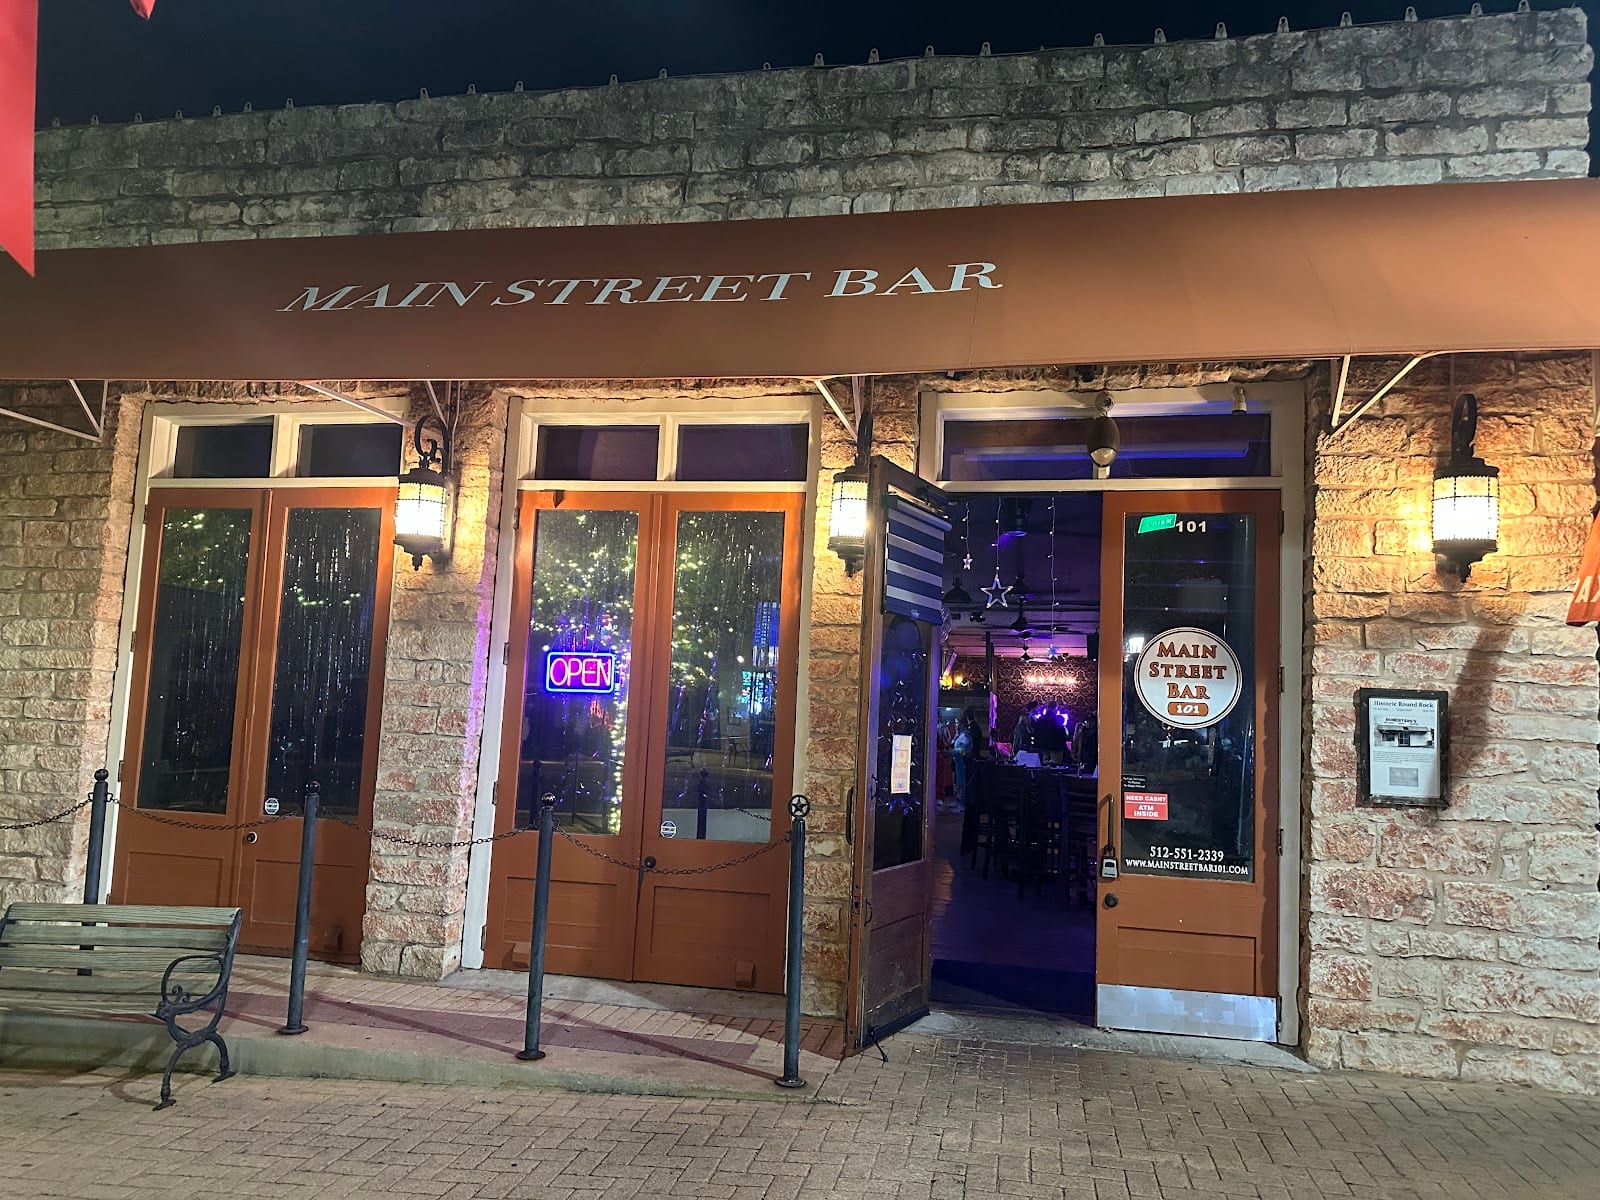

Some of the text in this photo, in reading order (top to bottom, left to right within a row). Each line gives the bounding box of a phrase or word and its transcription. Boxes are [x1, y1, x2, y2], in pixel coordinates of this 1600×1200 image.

[275, 262, 1004, 312] MAIN STREET BAR
[1176, 520, 1206, 533] 101
[1157, 641, 1218, 659] MAIN
[550, 658, 611, 687] OPEN
[1149, 662, 1227, 679] STREET
[1167, 682, 1210, 699] BAR
[1176, 704, 1200, 714] 101
[1149, 846, 1225, 862] 512-551-2339
[1125, 859, 1249, 875] WWW.MAINSTREETBAR101.COM
